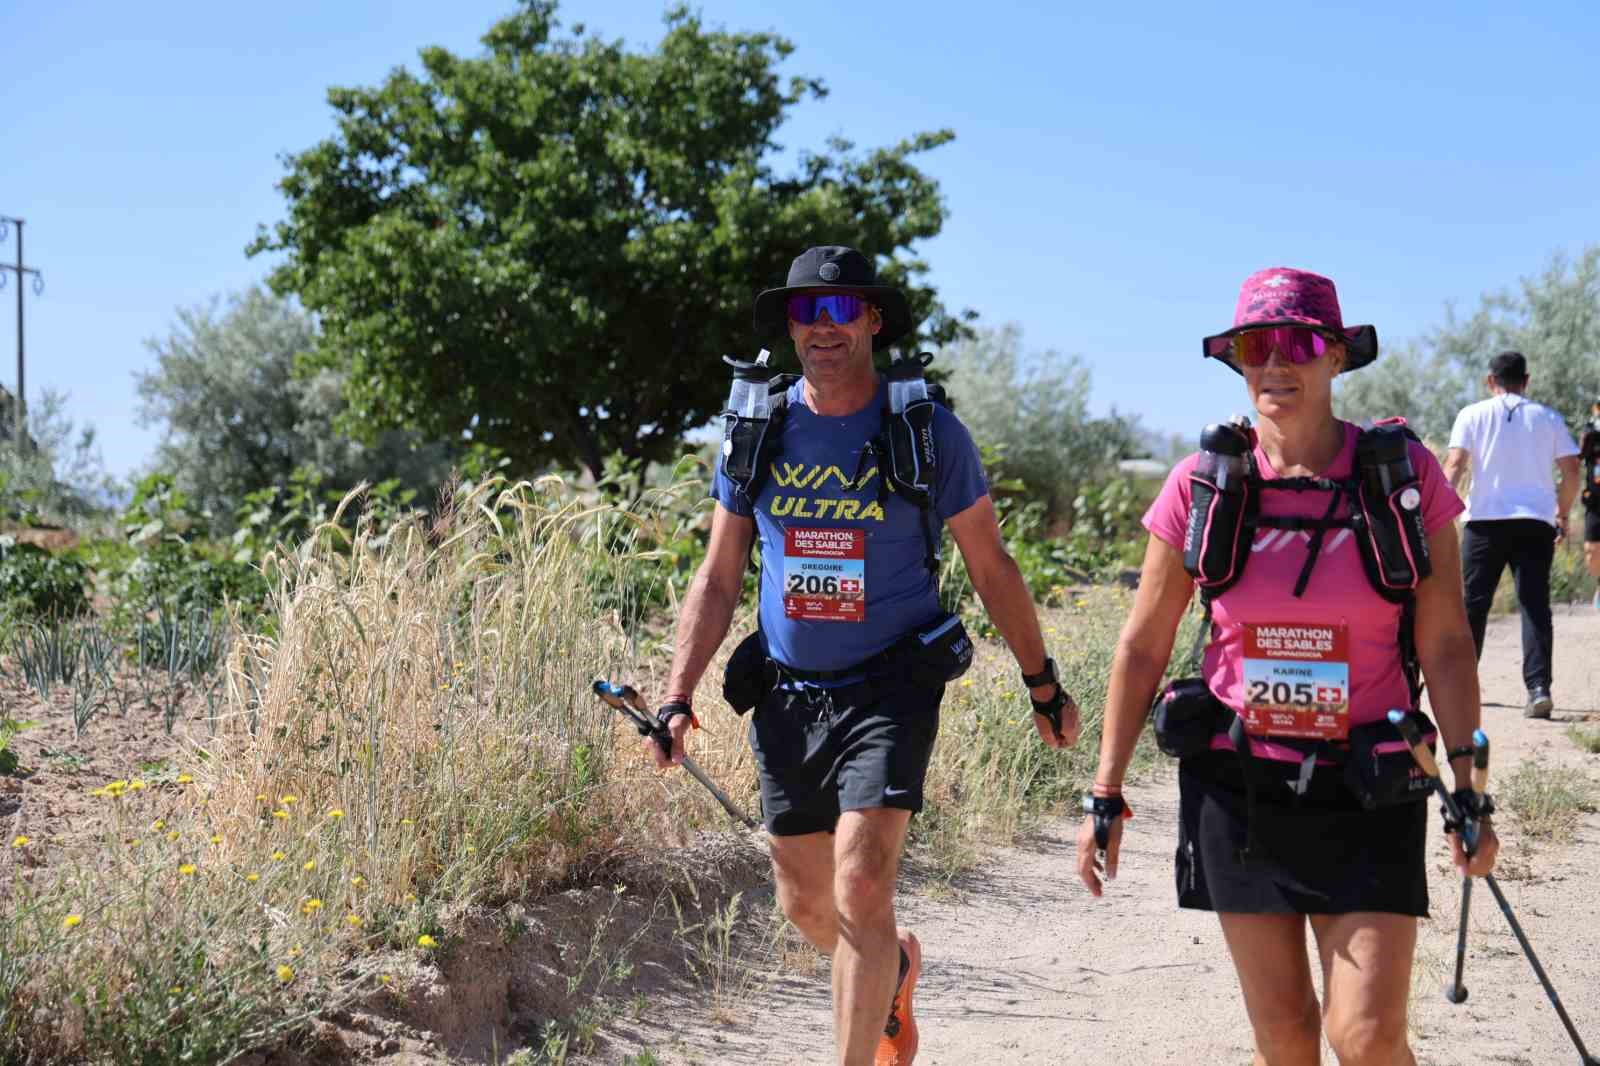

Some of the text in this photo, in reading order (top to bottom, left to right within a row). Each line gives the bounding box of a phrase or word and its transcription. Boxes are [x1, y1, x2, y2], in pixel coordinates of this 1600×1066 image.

[770, 495, 885, 520] ULTRA
[795, 531, 854, 541] MARATHON
[795, 540, 853, 550] DES SABLES
[790, 575, 838, 595] 206
[1256, 627, 1333, 640] MARATHON
[1256, 638, 1333, 652] DES SABLES
[1273, 667, 1313, 677] KARINE
[1251, 680, 1313, 706] 205
